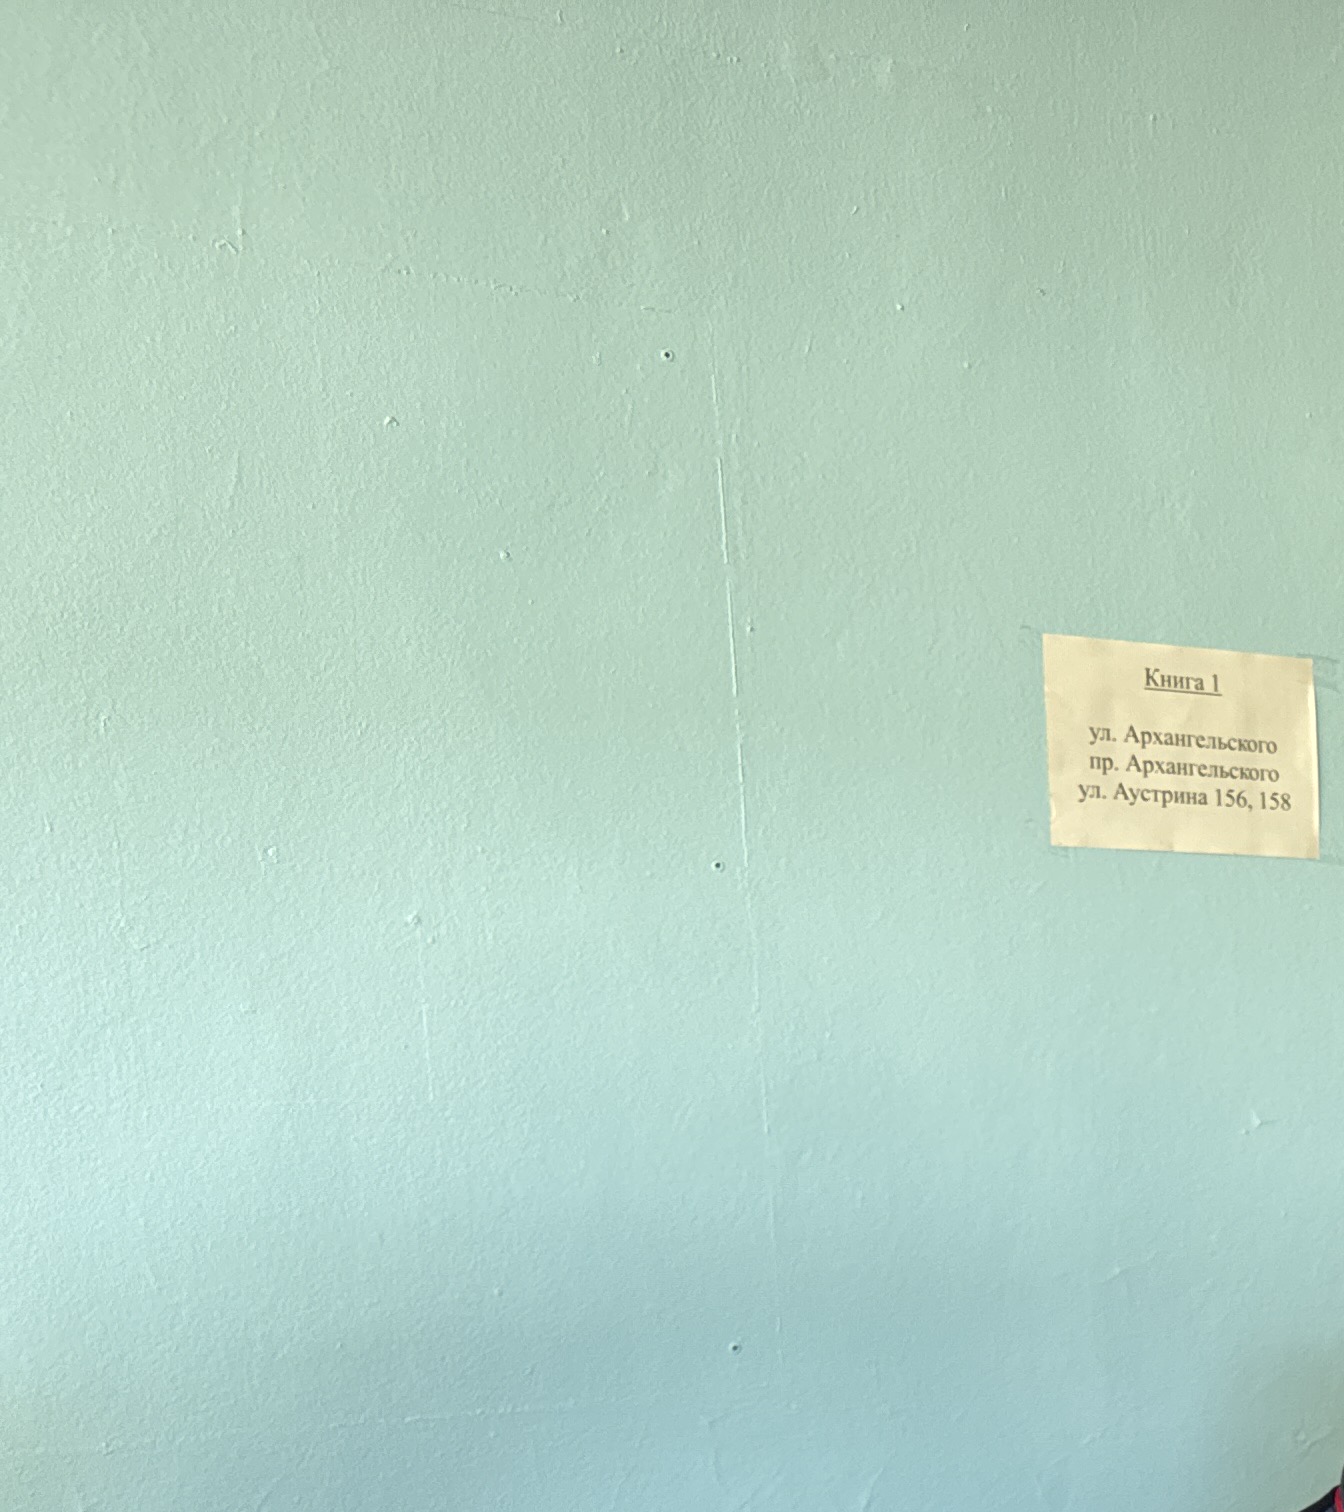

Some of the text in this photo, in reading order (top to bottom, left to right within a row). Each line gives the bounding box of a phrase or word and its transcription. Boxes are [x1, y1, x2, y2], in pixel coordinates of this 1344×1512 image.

[1144, 667, 1219, 692] Книга 1
[1089, 724, 1278, 754] ул. Архангельского
[1089, 754, 1280, 783] пр. Архангельского
[1077, 783, 1292, 812] ул. Аустрина 156, 158
